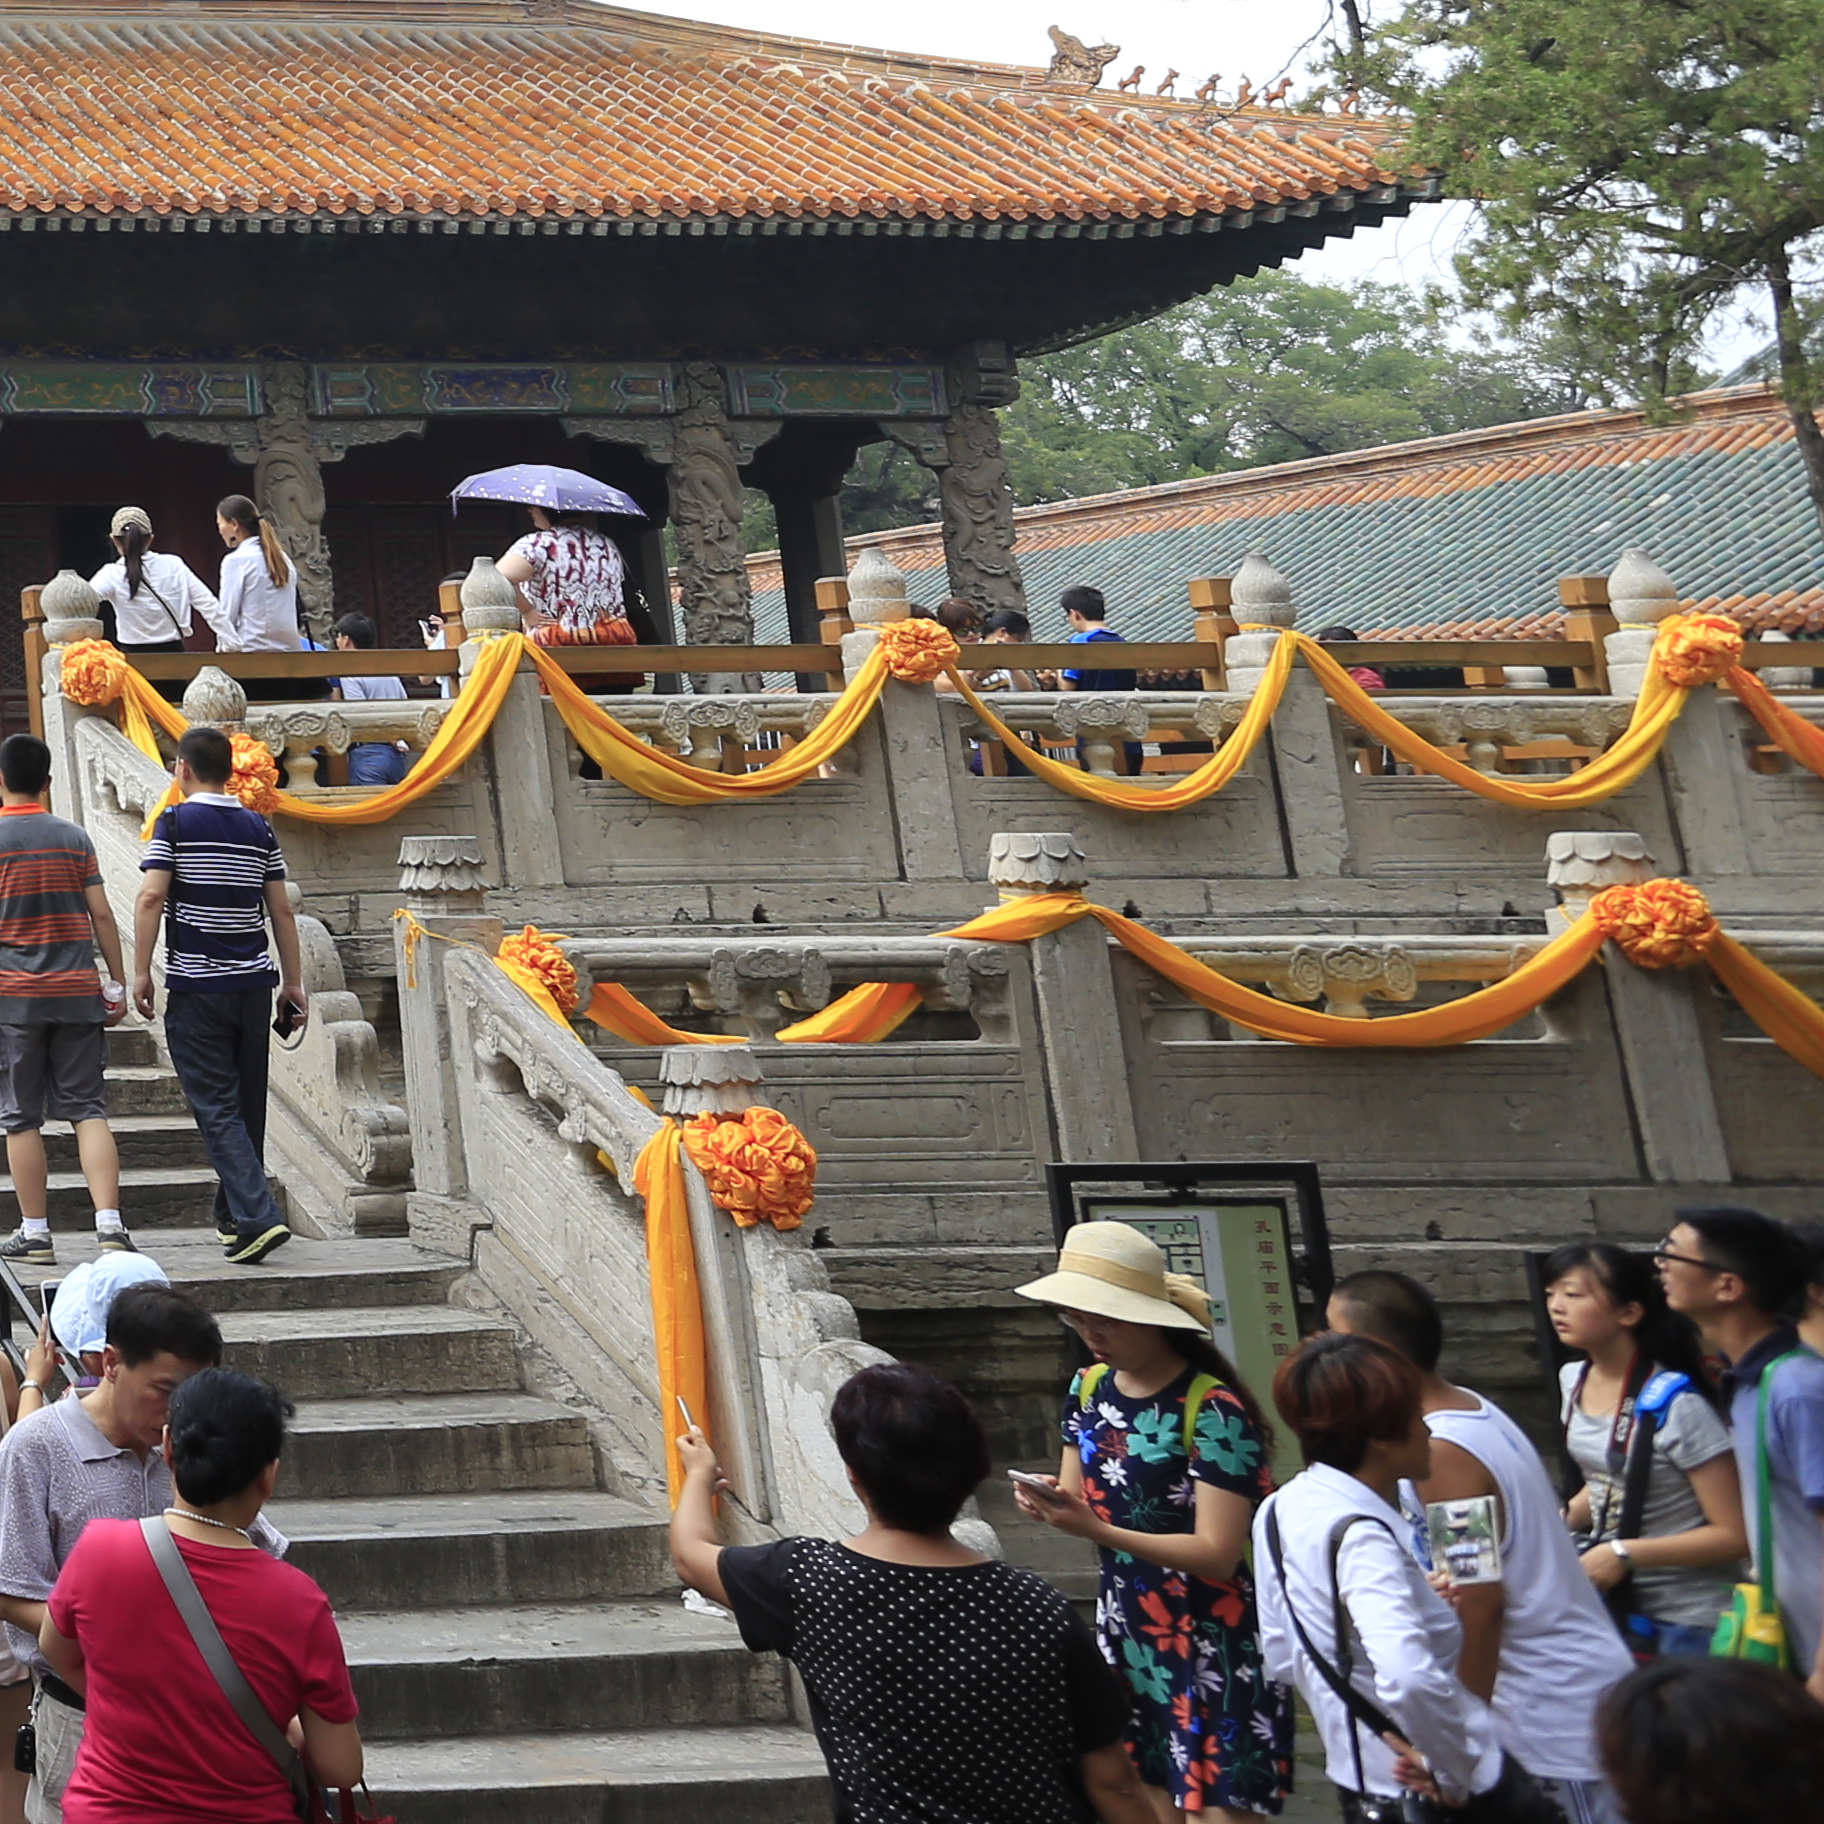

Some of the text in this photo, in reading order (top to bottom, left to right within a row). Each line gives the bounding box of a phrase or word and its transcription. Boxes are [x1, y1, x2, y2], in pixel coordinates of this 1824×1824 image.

[1254, 1220, 1289, 1357] 孔庙平面示意图
